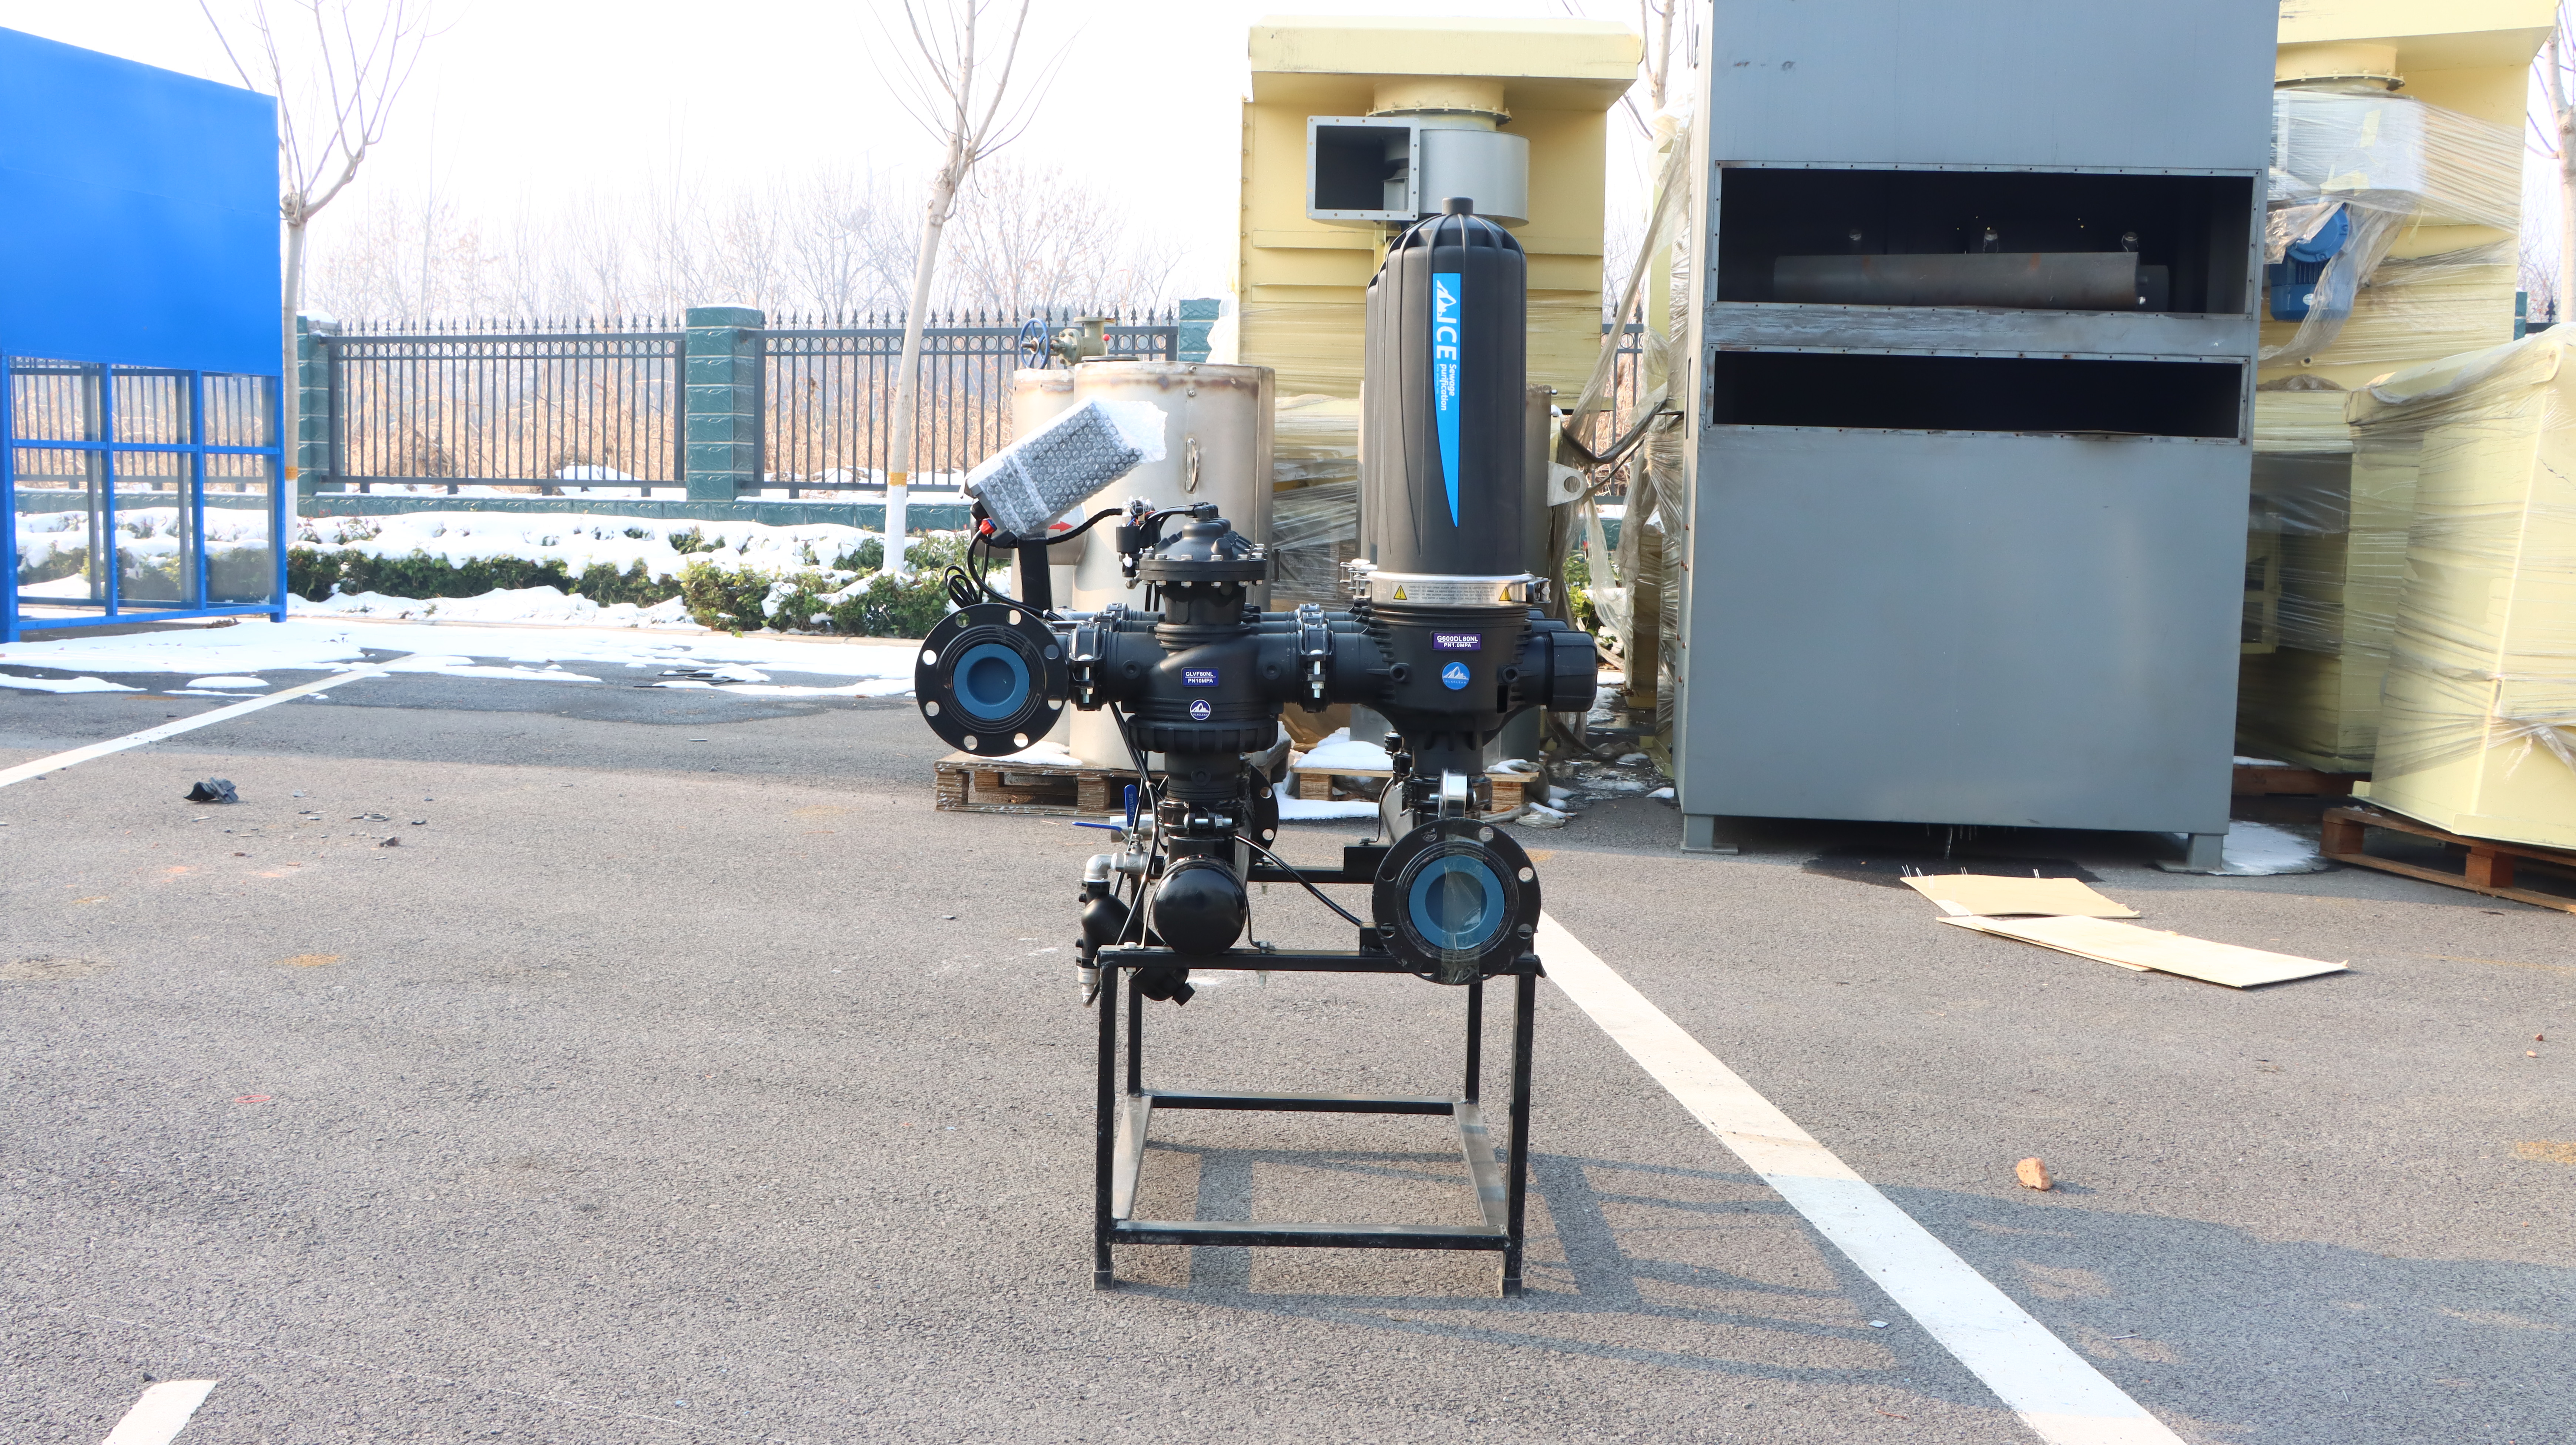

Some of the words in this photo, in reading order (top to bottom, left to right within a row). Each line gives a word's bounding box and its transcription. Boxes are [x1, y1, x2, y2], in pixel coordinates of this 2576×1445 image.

[1437, 317, 1457, 360] ICE
[1439, 364, 1449, 410] purification
[1447, 364, 1457, 396] Sewage
